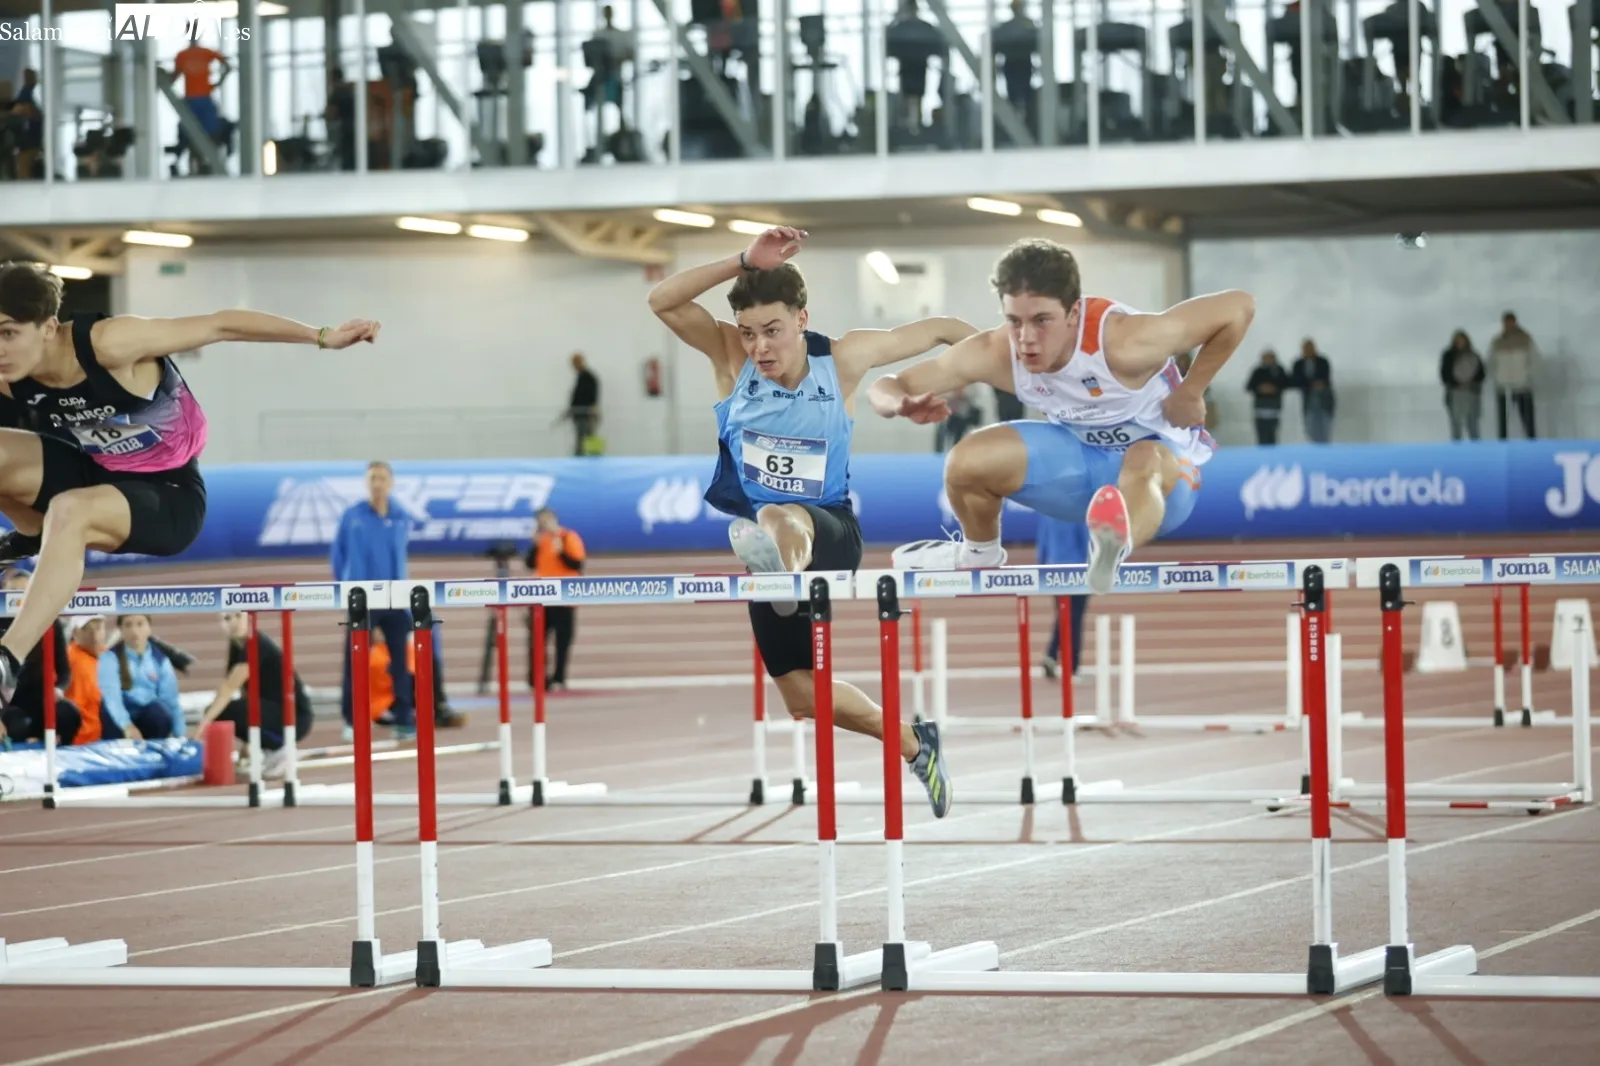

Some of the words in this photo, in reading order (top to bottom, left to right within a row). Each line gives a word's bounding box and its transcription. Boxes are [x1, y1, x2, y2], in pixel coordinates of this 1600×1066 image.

[91, 427, 123, 444] 18
[1086, 427, 1131, 445] 496
[101, 437, 144, 455] oma
[766, 454, 794, 475] 63
[757, 470, 805, 493] Joma
[1309, 469, 1465, 507] Iberdrola
[1123, 570, 1152, 585] 2025
[1163, 567, 1214, 585] Joma
[1497, 561, 1550, 578] Joma
[567, 581, 639, 597] SALAMANCA
[641, 580, 667, 595] 2025
[678, 580, 725, 596] Joma
[985, 572, 1034, 589] Joma
[121, 592, 189, 608] SALAMANCA
[190, 591, 216, 606] 2025
[226, 591, 270, 606] Joma
[511, 584, 557, 599] Joma
